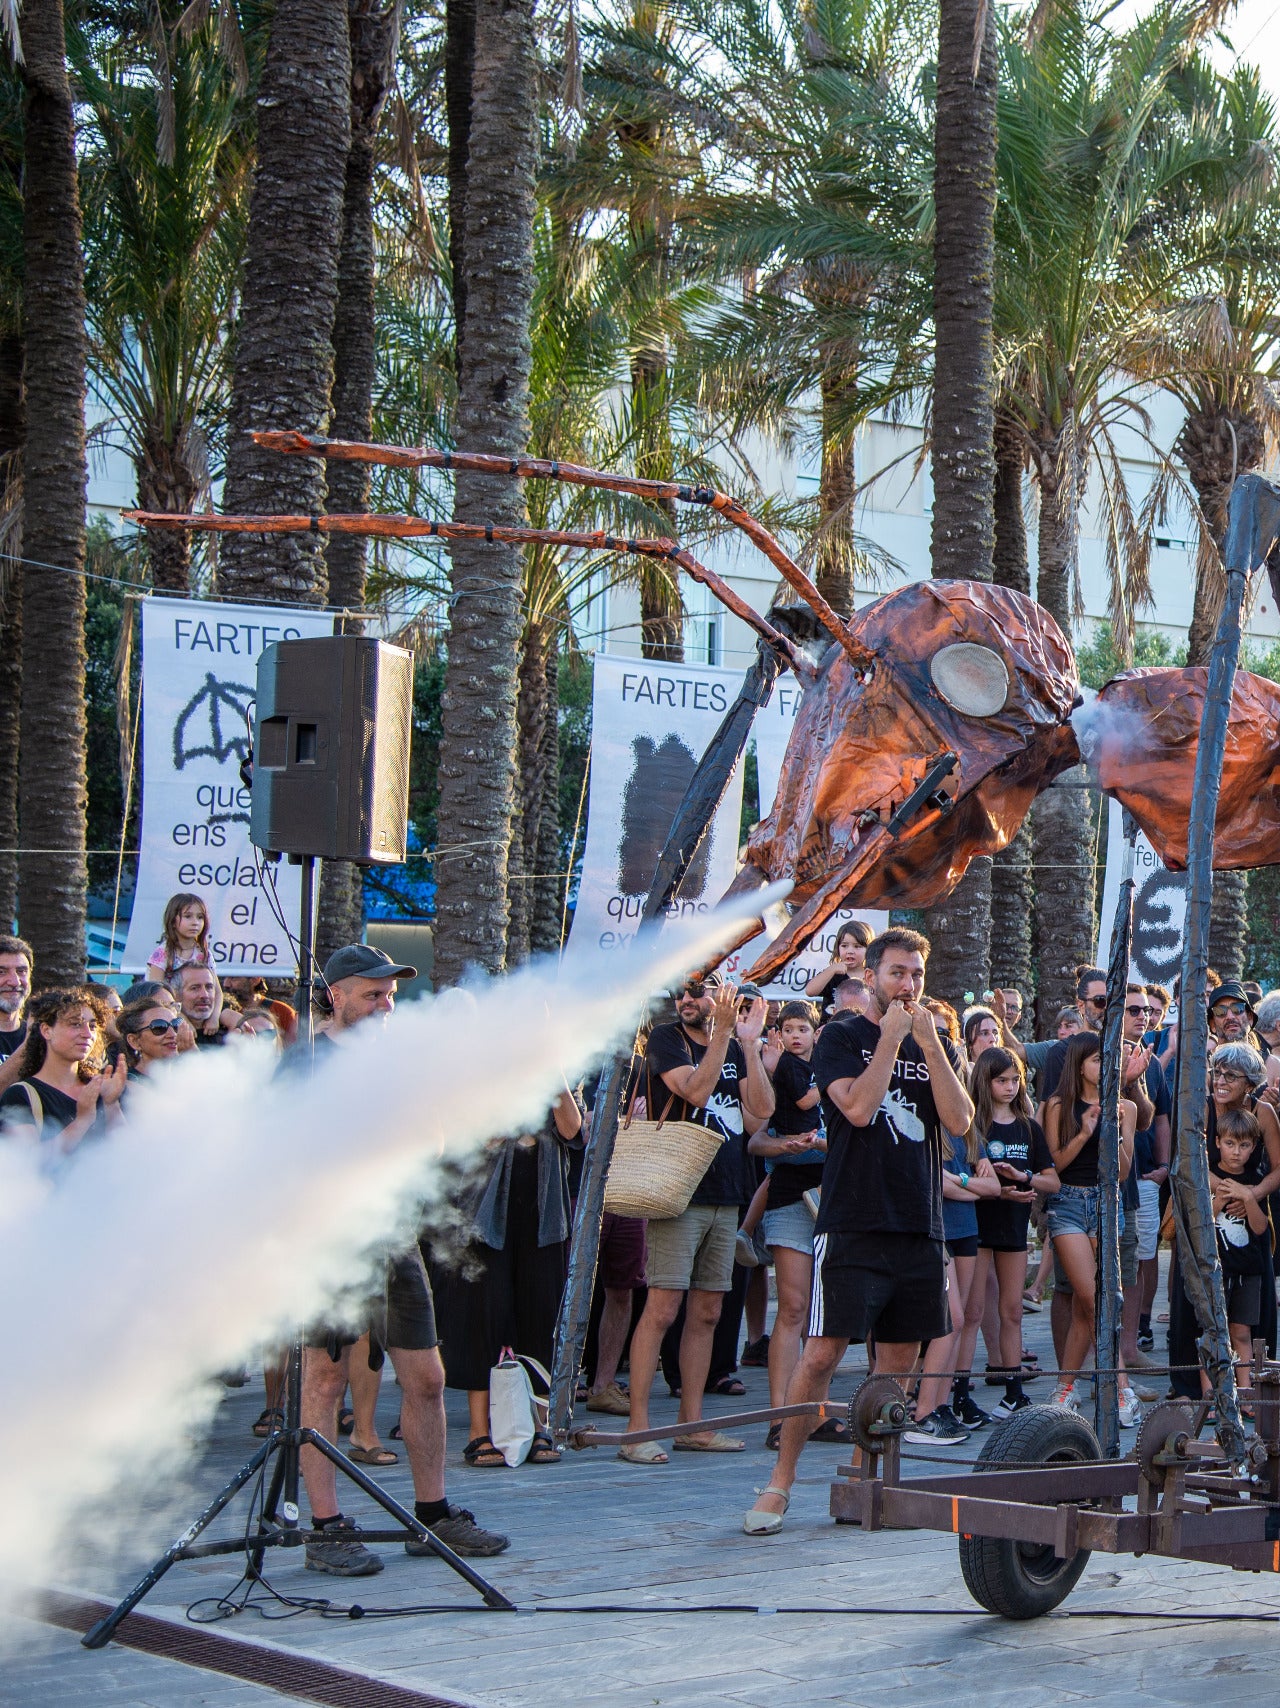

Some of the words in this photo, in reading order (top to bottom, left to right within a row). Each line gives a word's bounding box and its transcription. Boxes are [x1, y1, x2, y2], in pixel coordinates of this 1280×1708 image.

[622, 674, 727, 712] FARTES
[196, 784, 251, 815] que
[172, 823, 227, 847] ens
[230, 896, 258, 926] el
